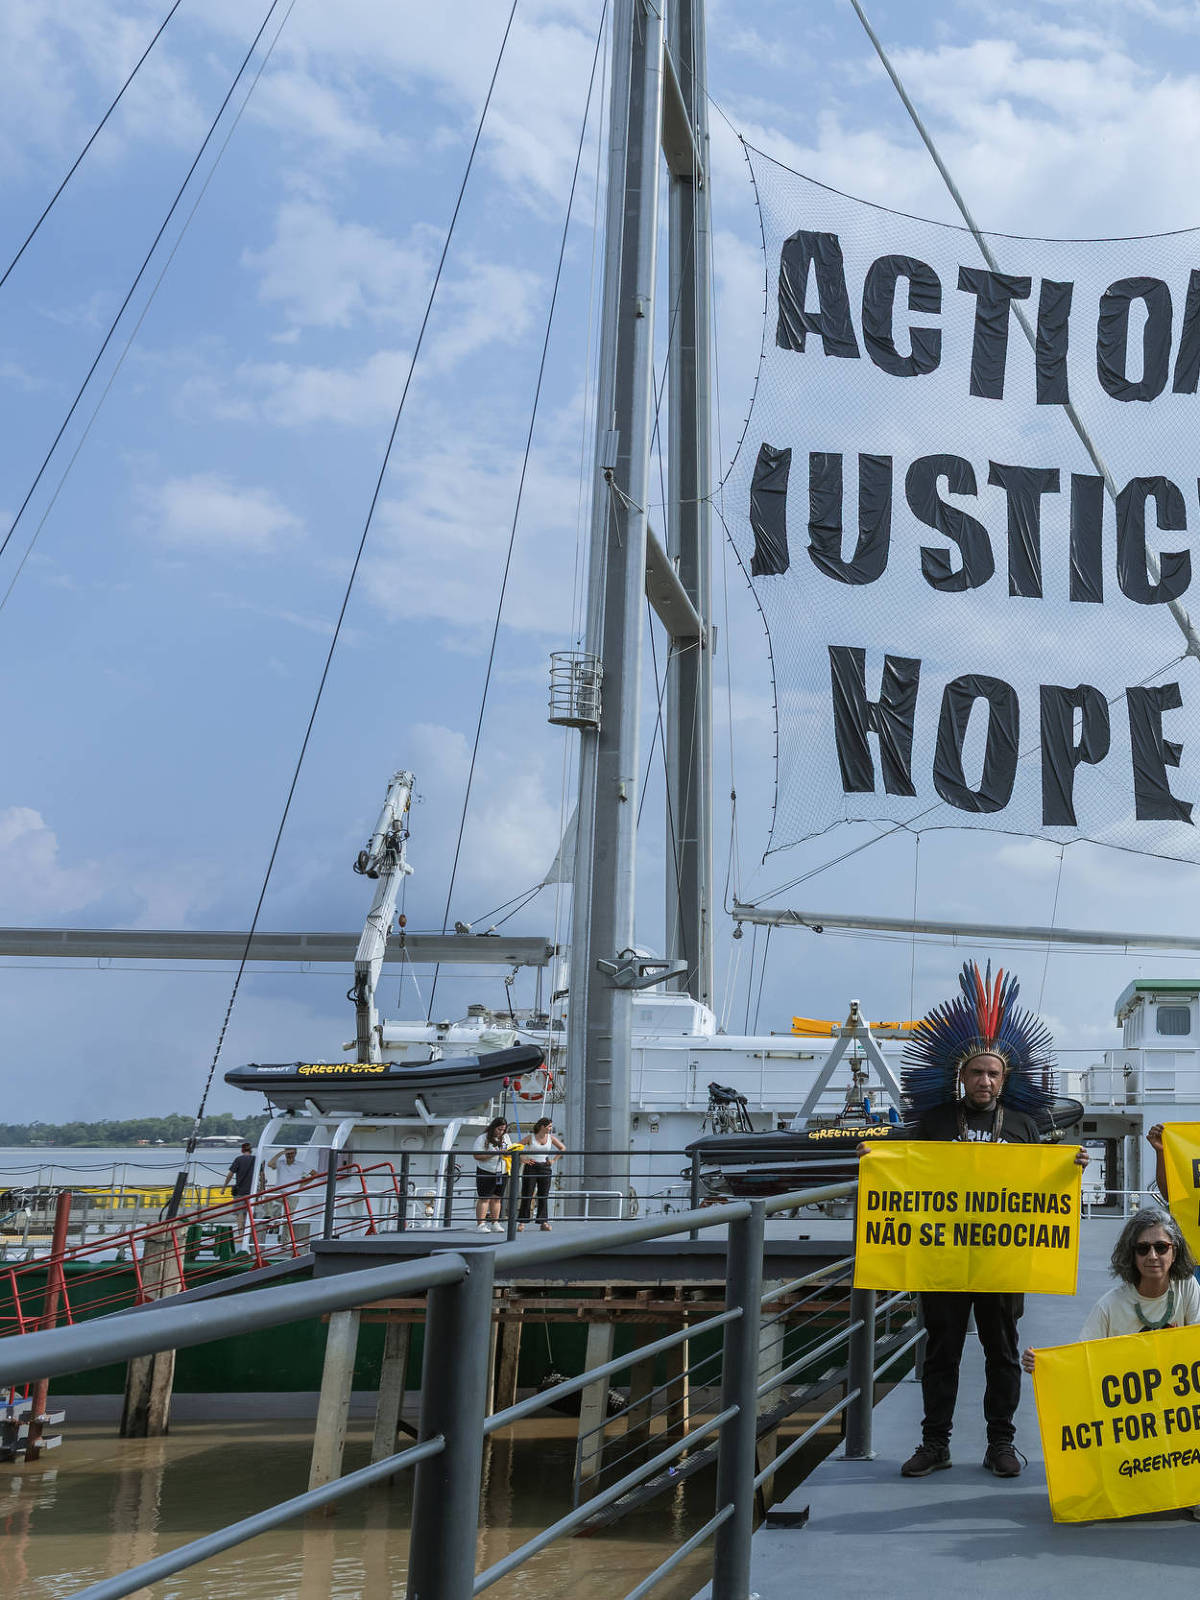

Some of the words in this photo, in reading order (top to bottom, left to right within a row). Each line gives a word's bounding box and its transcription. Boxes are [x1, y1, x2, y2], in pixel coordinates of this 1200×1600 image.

[828, 644, 1195, 827] HOPE
[298, 1063, 390, 1076] GREENPEACE
[808, 1126, 893, 1141] GREENPEACE
[867, 1189, 958, 1213] DIREITOS
[965, 1187, 1072, 1215] INDÍGENAS
[865, 1217, 912, 1246] NÃO
[919, 1222, 946, 1247] SE
[953, 1222, 1071, 1249] NEGOCIAM
[1101, 1368, 1162, 1408] COP
[1060, 1420, 1104, 1451] ACT
[1112, 1412, 1158, 1443] FOR
